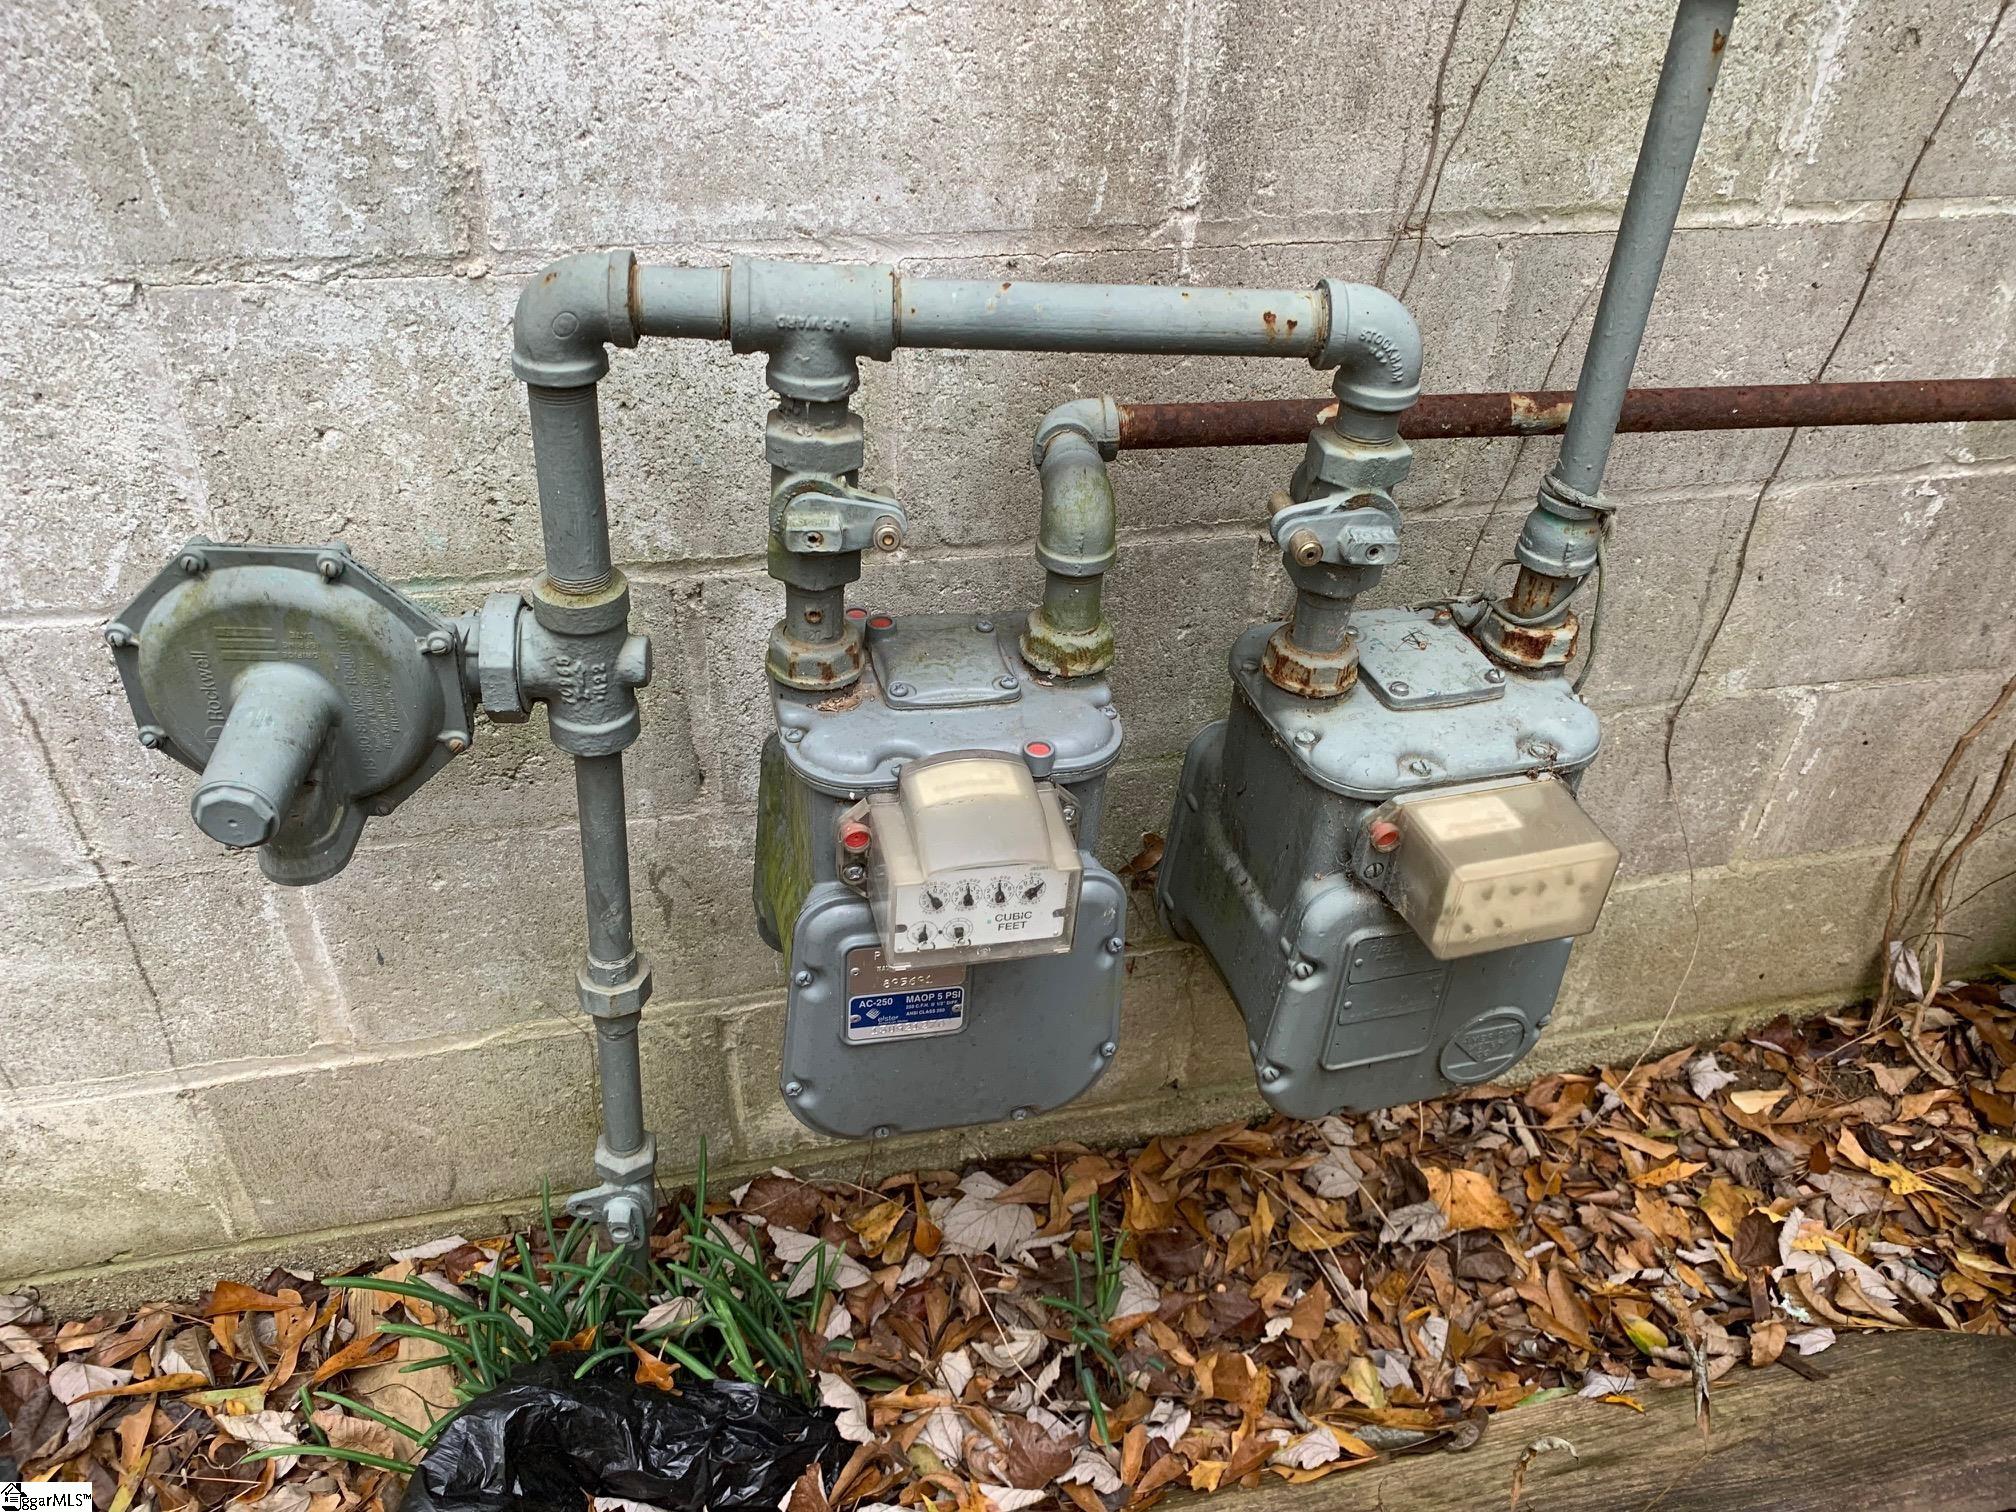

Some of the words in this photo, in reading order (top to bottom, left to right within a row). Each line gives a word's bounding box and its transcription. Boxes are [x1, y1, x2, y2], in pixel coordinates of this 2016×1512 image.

[1359, 328, 1404, 384] STOCKHAM
[190, 650, 225, 722] Rockwell
[995, 911, 1032, 922] CUBIC
[997, 921, 1027, 931] FEET
[859, 997, 893, 1009] AC-250
[906, 993, 935, 1004] MAOP
[937, 992, 943, 1000] 5
[945, 990, 961, 999] PSI
